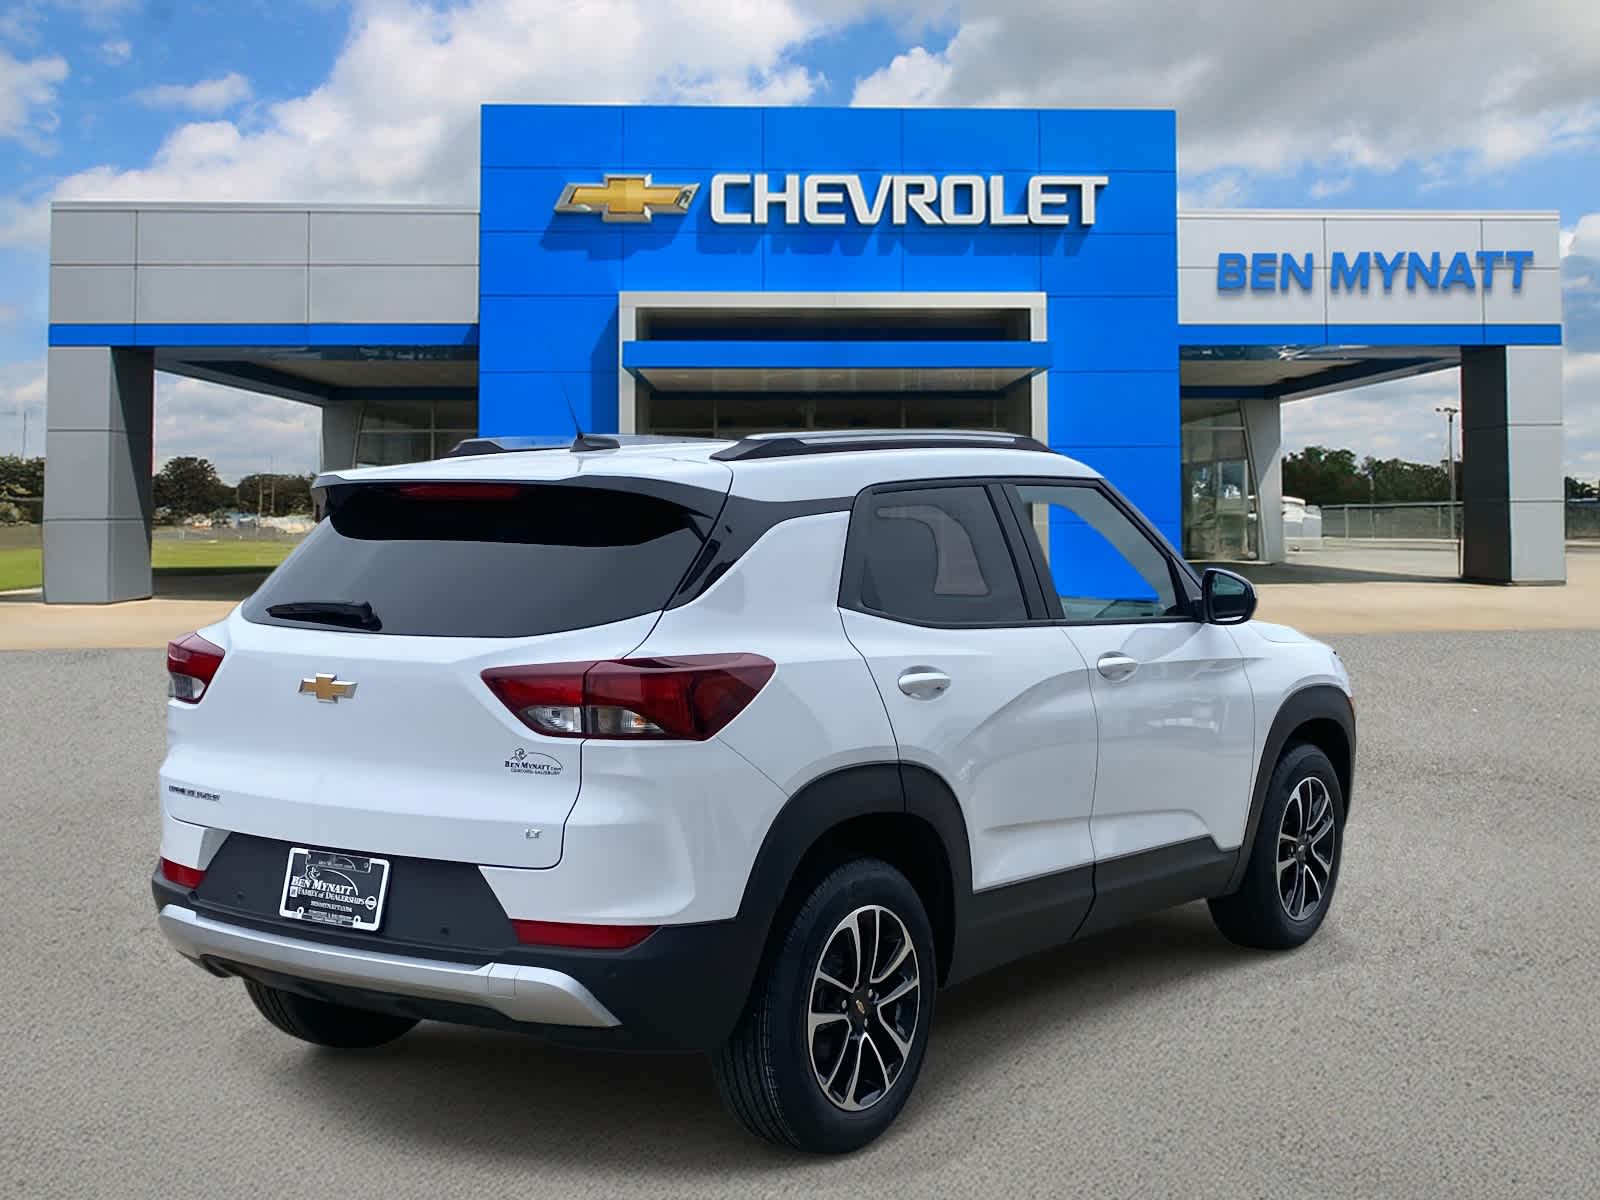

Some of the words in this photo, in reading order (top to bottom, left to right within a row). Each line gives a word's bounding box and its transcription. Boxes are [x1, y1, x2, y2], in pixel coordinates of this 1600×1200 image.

[710, 173, 1109, 226] CHEVROLET
[1217, 252, 1314, 291] BEN
[1330, 250, 1534, 291] MYNATT
[504, 760, 521, 769] BEN
[291, 875, 312, 891] BEN
[312, 879, 354, 896] MYNATT
[297, 887, 318, 897] FAMILY
[325, 891, 366, 906] DEALERSHIPS
